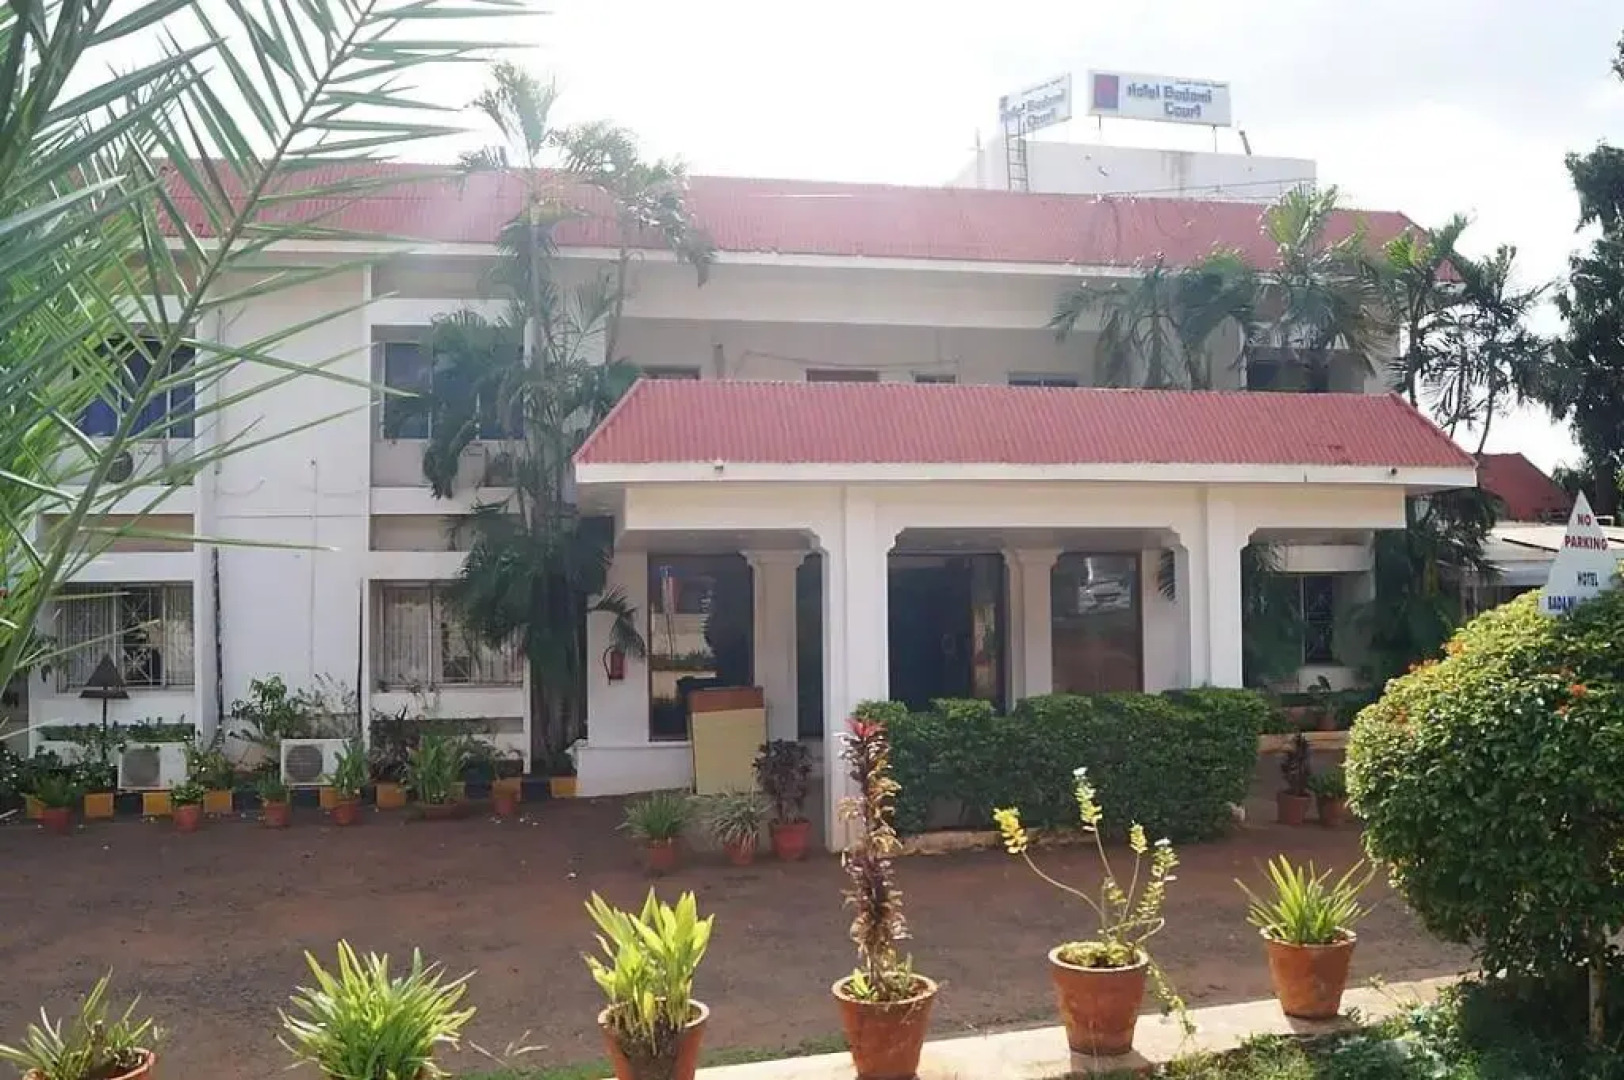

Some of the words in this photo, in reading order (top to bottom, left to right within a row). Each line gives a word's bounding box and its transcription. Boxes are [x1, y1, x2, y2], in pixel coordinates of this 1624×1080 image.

[1128, 82, 1160, 98] Hotel
[1164, 102, 1202, 117] Court
[1577, 514, 1591, 526] NO
[1565, 535, 1608, 550] PARKING
[1577, 571, 1598, 587] HOTEL
